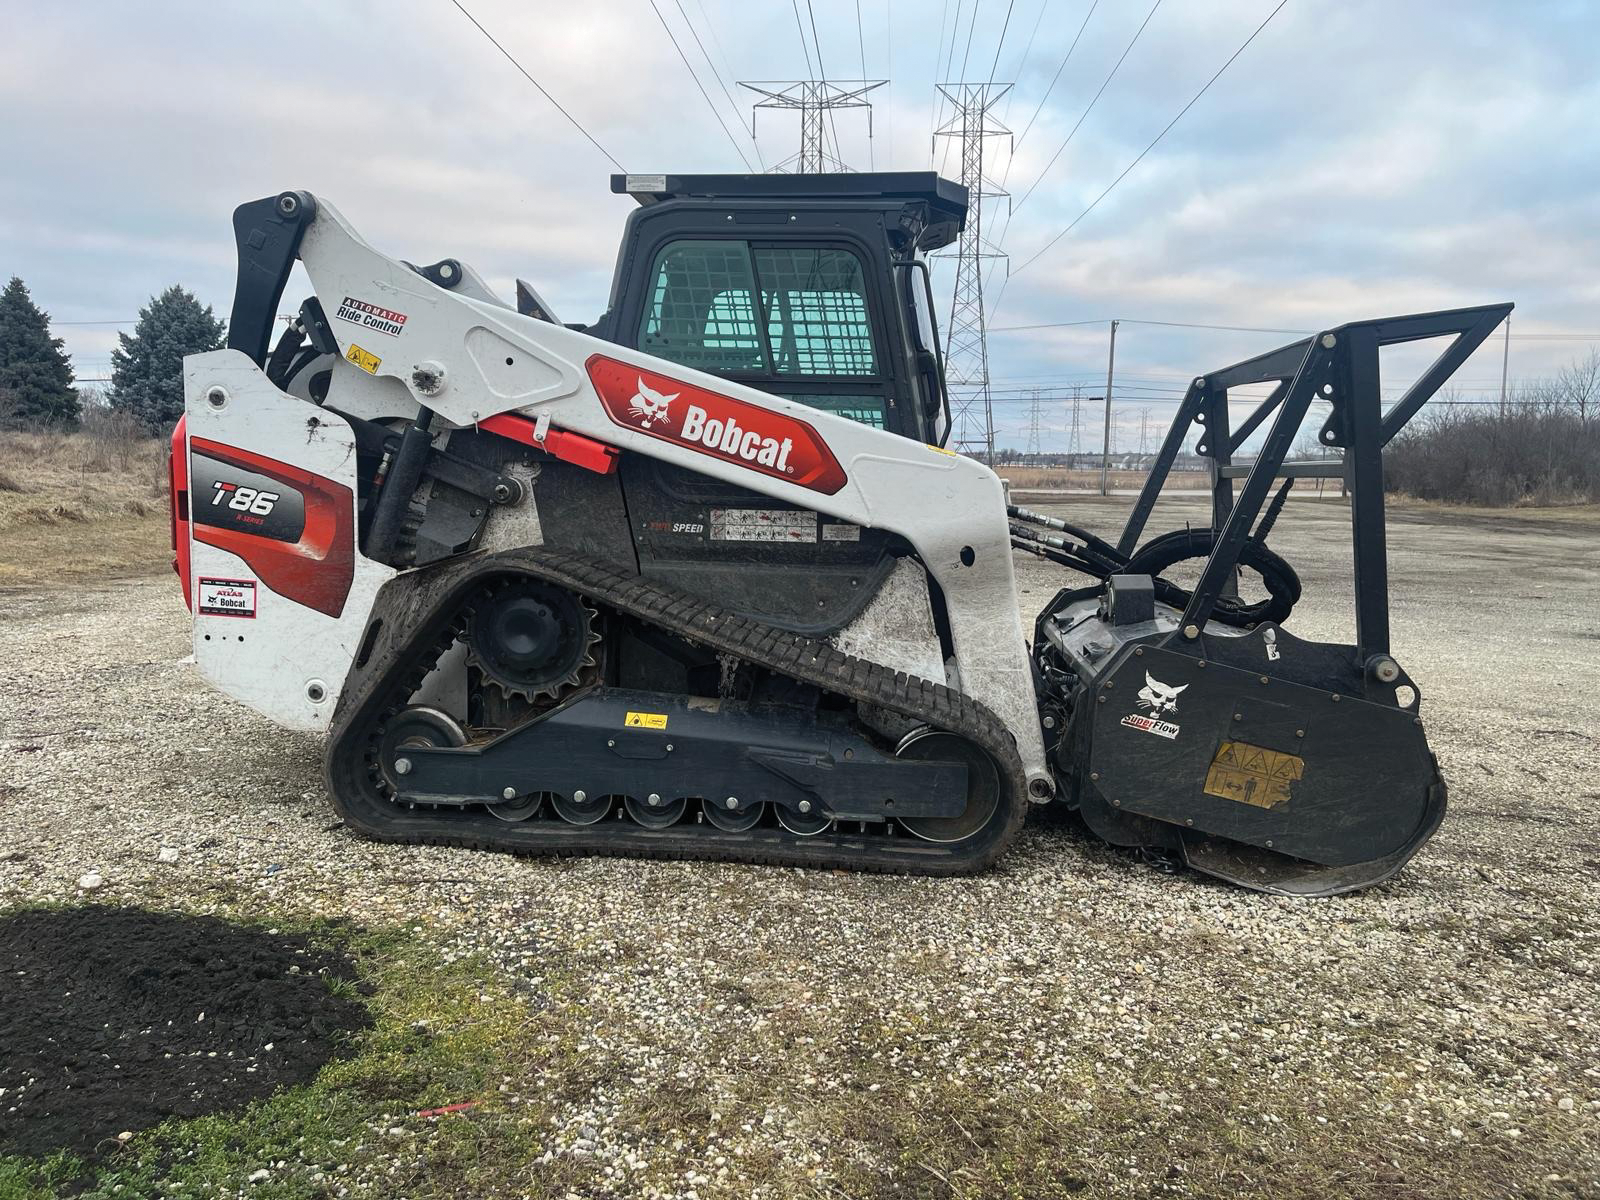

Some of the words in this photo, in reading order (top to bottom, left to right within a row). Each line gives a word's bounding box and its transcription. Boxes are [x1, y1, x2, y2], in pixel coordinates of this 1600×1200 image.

[336, 306, 361, 322] Ride
[363, 314, 403, 336] Control
[345, 299, 404, 323] AUTOMATIC
[680, 404, 793, 473] Bobcat
[211, 481, 280, 516] T86
[673, 523, 703, 533] SPEED
[220, 598, 246, 608] Bobcat
